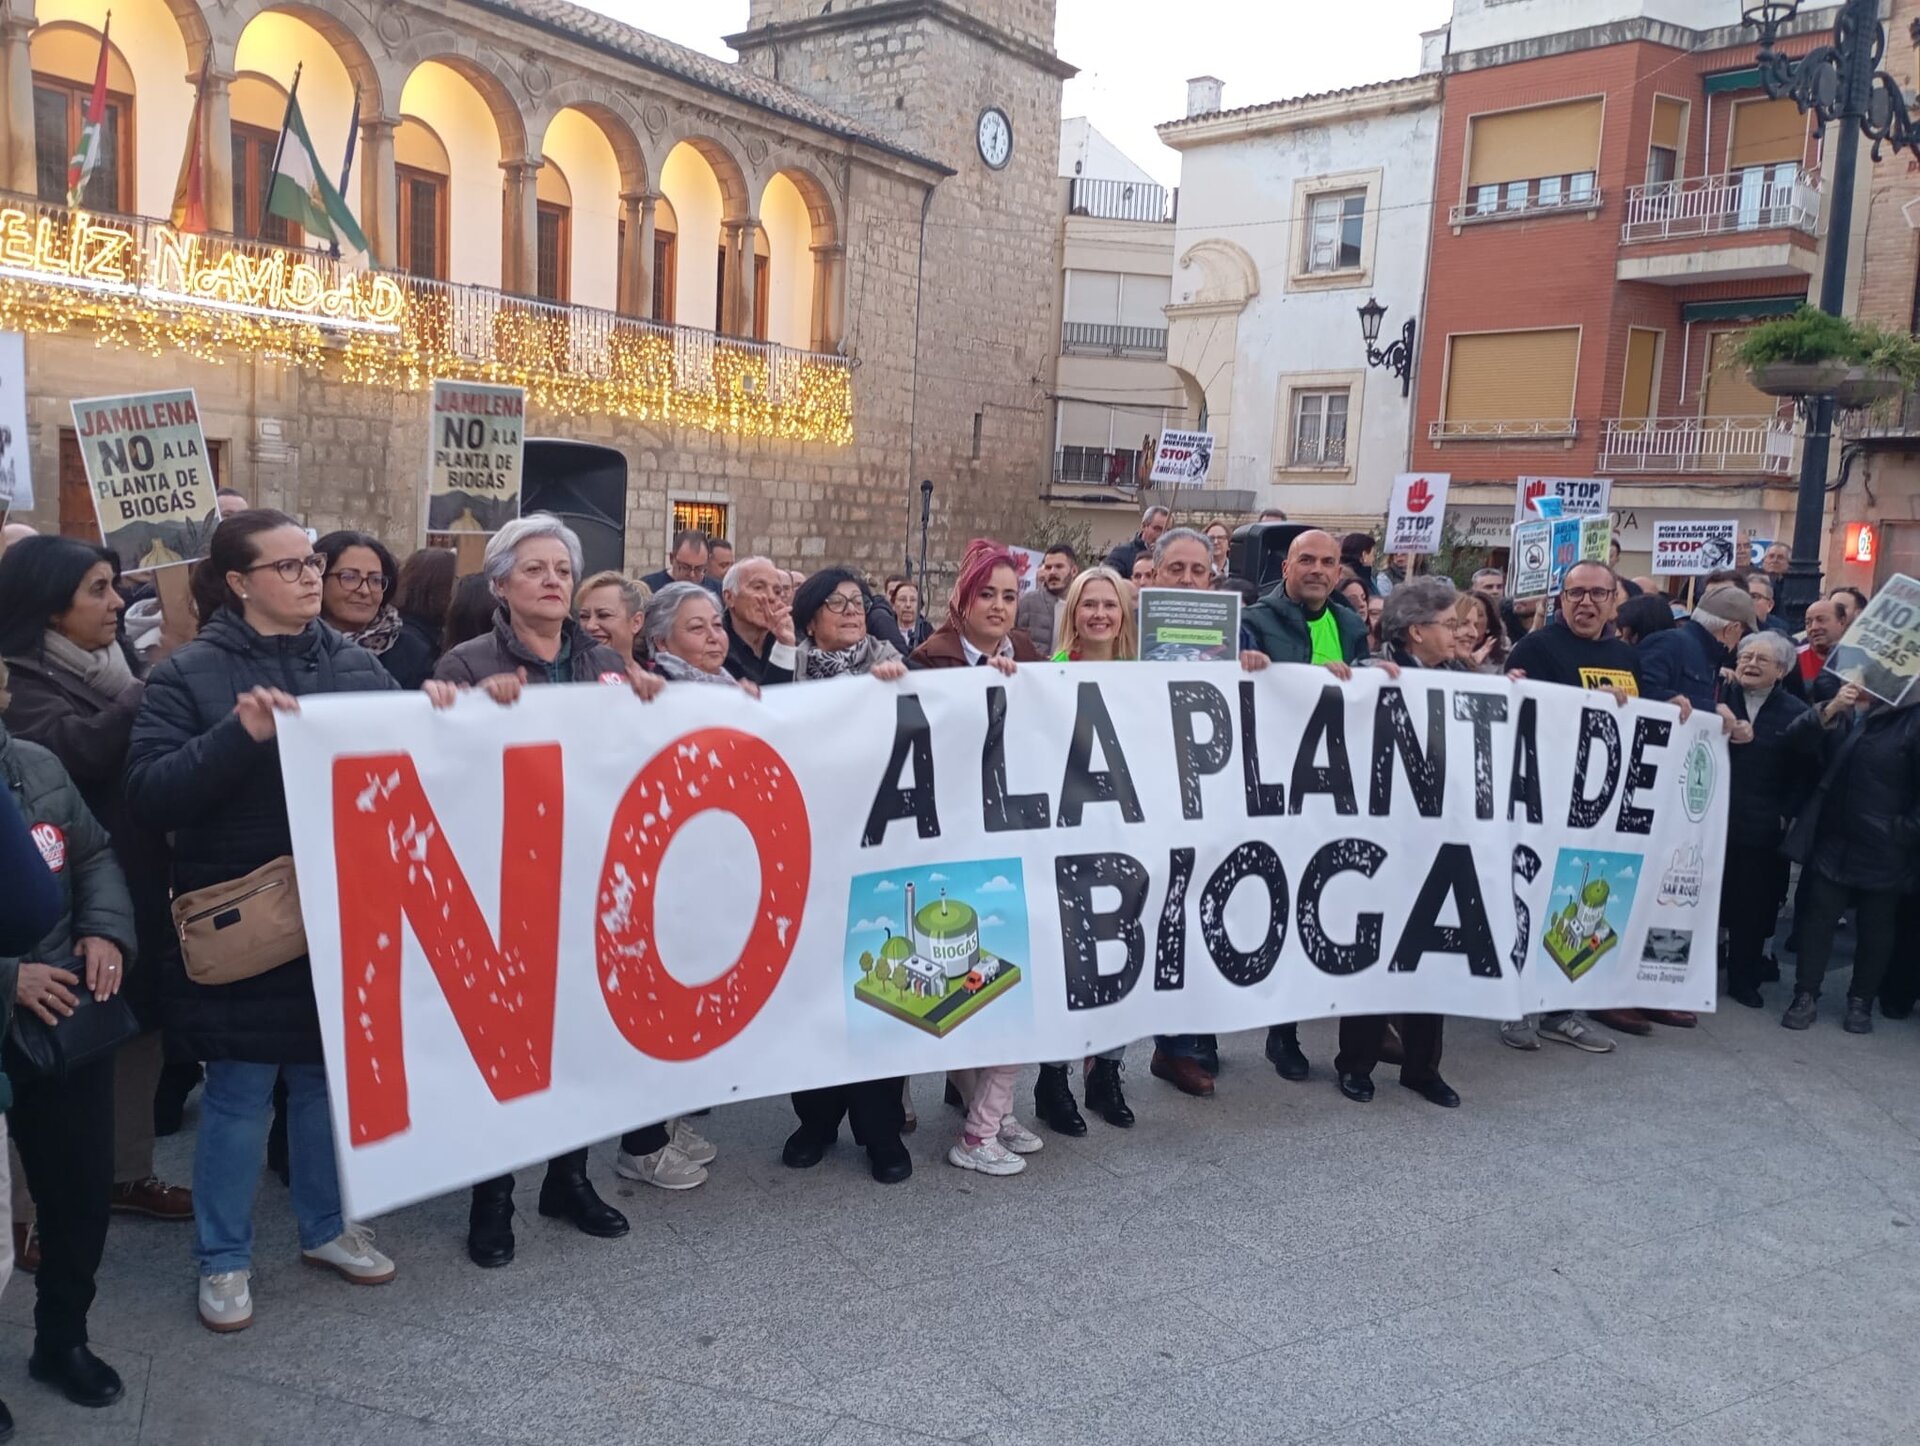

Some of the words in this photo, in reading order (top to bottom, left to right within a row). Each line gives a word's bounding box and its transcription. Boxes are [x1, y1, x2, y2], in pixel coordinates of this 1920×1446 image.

[153, 227, 402, 322] NAVIDAD
[435, 389, 523, 417] JAMILENA
[80, 400, 199, 437] JAMILENA
[443, 417, 485, 450] NO
[490, 428, 500, 446] A
[502, 429, 518, 446] LA
[97, 435, 154, 477] NO
[163, 442, 175, 460] A
[177, 439, 199, 459] LA
[434, 450, 490, 469] PLANTA
[494, 454, 513, 471] DE
[1159, 447, 1193, 461] STOP
[97, 472, 170, 499] PLANTA
[175, 468, 200, 489] DE
[1555, 481, 1601, 499] STOP
[119, 489, 197, 519] BIOGÁS
[1561, 499, 1601, 508] LANTA
[1396, 515, 1435, 530] STOP
[1658, 541, 1703, 552] STOP
[1873, 598, 1912, 630] NO
[1856, 617, 1903, 646] PLANTA
[31, 825, 56, 850] NO
[333, 726, 812, 1149] NO
[860, 693, 941, 848] A
[981, 681, 1146, 833] LA
[1167, 680, 1544, 824] PLANTA
[1567, 706, 1673, 834] DE
[1054, 837, 1543, 1012] BIOGAS
[932, 933, 977, 960] BIOGAS
